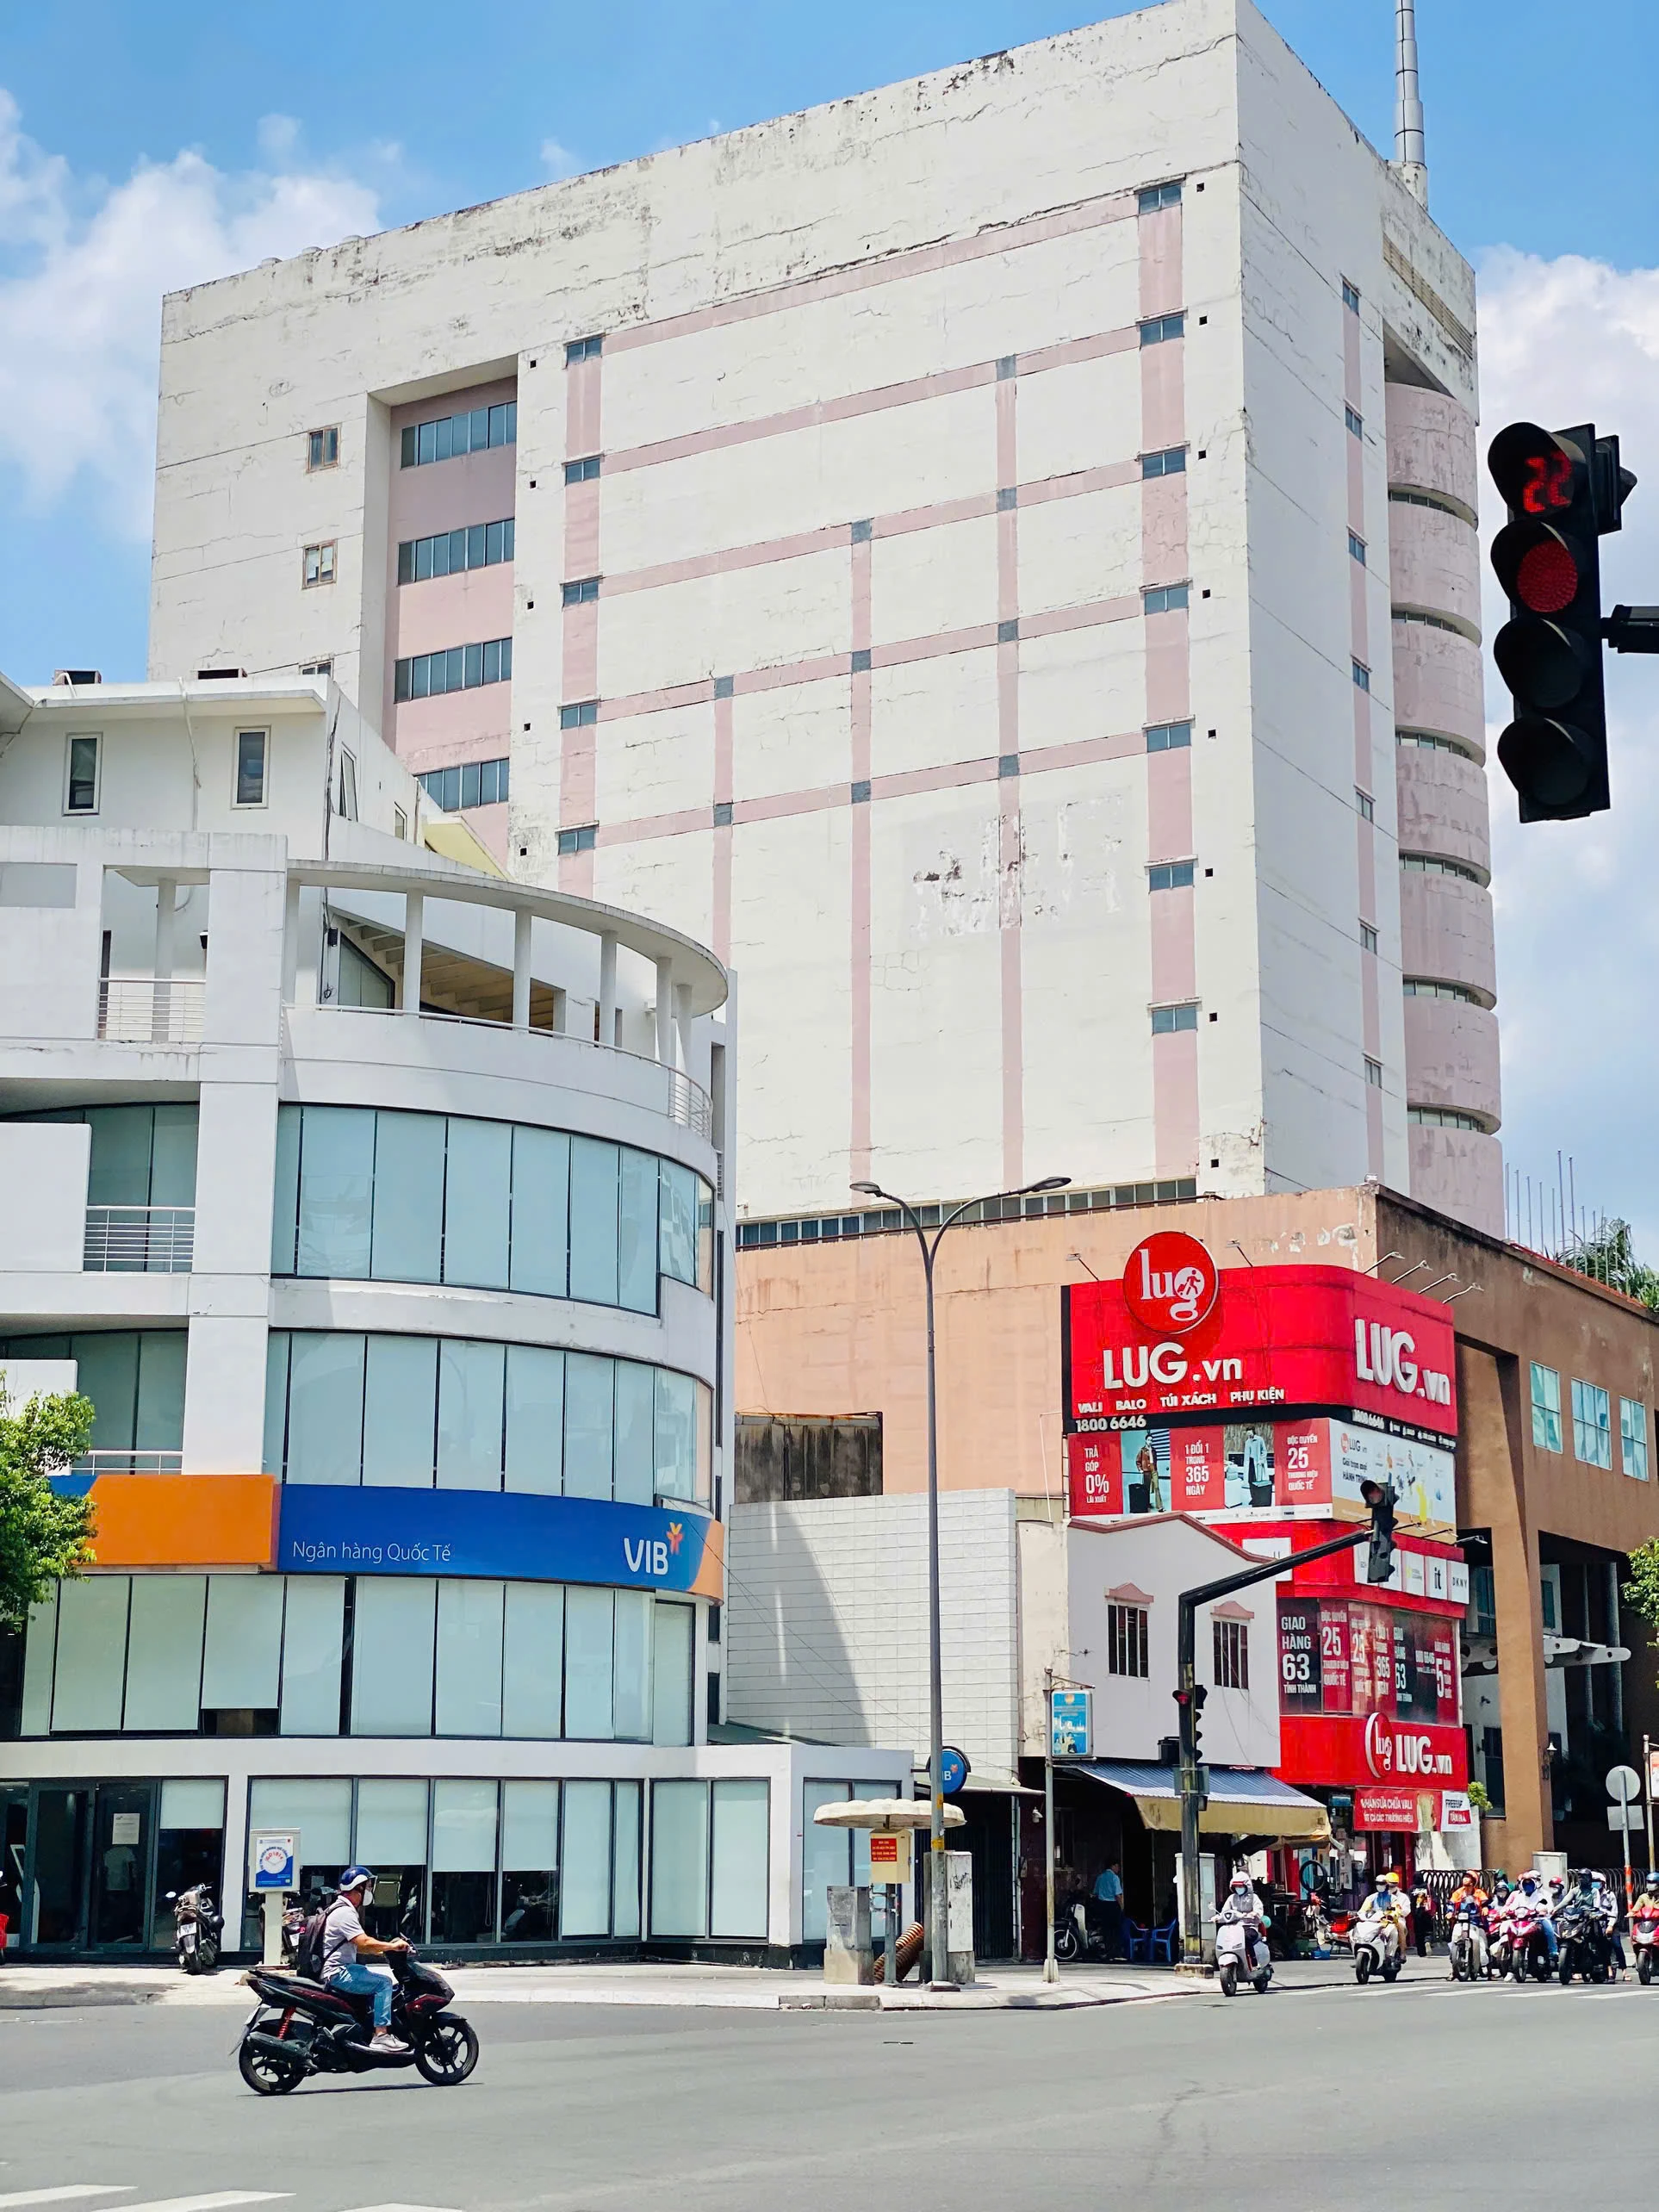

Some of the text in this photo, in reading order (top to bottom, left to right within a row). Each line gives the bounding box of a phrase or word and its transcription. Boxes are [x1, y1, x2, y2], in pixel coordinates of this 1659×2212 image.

[1138, 1248, 1205, 1321] lug
[1103, 1342, 1242, 1389] LUG.vn
[1355, 1318, 1451, 1405] LUG.vn
[1078, 1387, 1284, 1414] VALI BALO TÚI XÁCH PHỤ KIỆN
[1076, 1414, 1146, 1432] 1800 6646
[1084, 1445, 1098, 1458] TRẢ
[1287, 1447, 1308, 1469] 25
[1084, 1461, 1099, 1472] GÓP
[1185, 1466, 1209, 1483] 365
[1085, 1474, 1109, 1494] 0%
[1185, 1484, 1205, 1496] NGÀY
[293, 1540, 451, 1563] Ngân hàng Quốc Tế
[624, 1538, 668, 1575] VIB
[1452, 1577, 1467, 1588] DKNY
[1281, 1616, 1306, 1631] GIAO
[1282, 1633, 1311, 1650] HÀNG
[1322, 1626, 1341, 1656] 25
[1283, 1653, 1310, 1681] 63
[1395, 1734, 1452, 1774] LUG.vn
